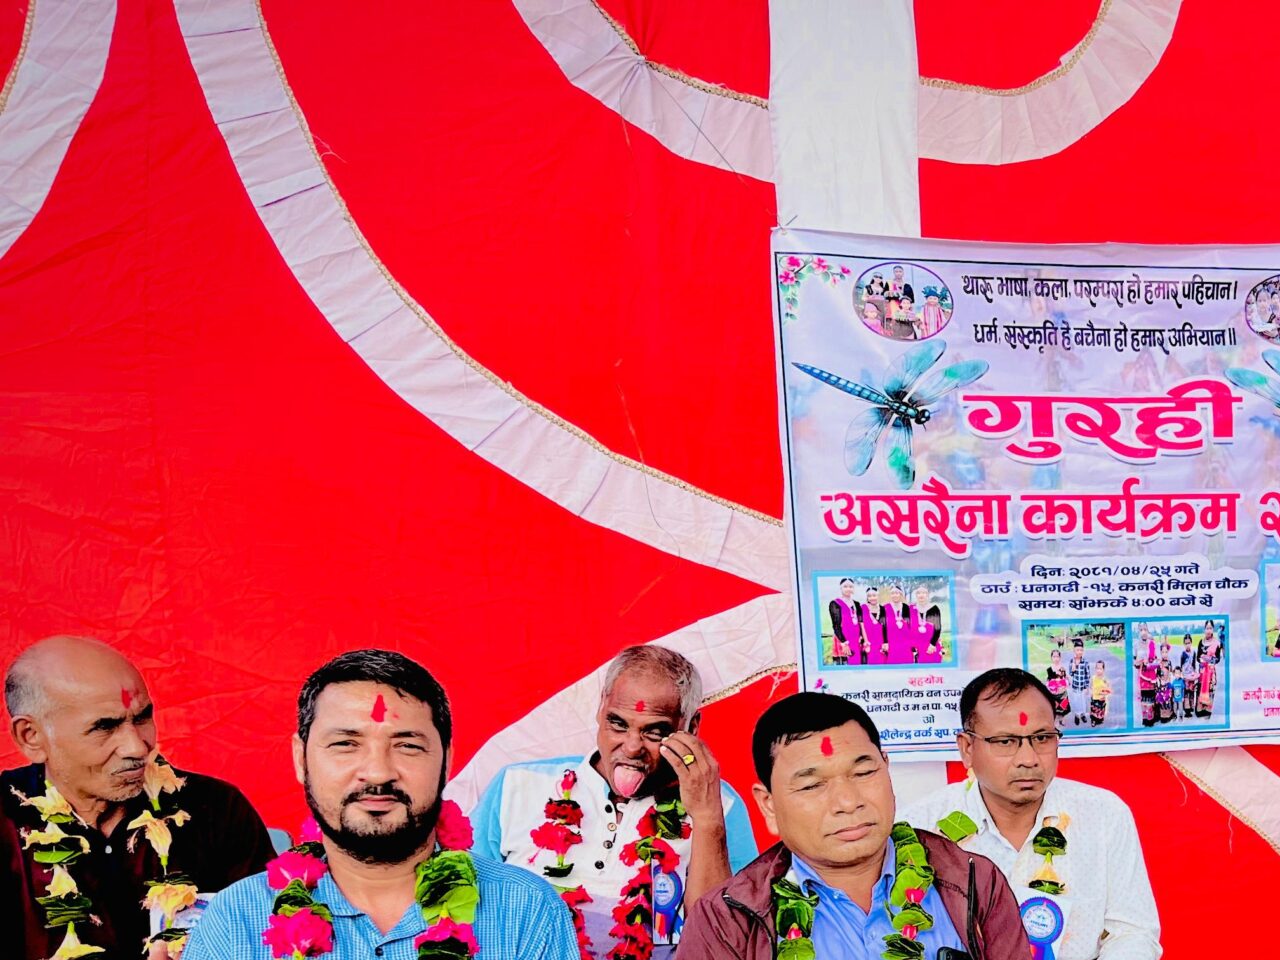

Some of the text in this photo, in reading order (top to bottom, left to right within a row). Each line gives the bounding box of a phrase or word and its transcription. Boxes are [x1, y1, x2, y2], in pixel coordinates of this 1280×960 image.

[962, 275, 993, 303] थारू
[1074, 279, 1124, 307] परम्परा
[1127, 273, 1141, 304] हो
[1144, 280, 1182, 309] हमार
[1003, 320, 1058, 353] संस्कृति
[1073, 320, 1111, 347] बचैना
[1114, 321, 1127, 352] हो
[1130, 328, 1169, 355] हमार
[963, 380, 1243, 460] गुरही
[821, 476, 1011, 555] असरैना
[1021, 478, 1240, 540] कार्यक्रम
[1117, 578, 1164, 595] कनरी
[1167, 578, 1212, 591] मिलन
[1215, 577, 1250, 590] चौक
[1174, 562, 1200, 575] गते
[1169, 594, 1196, 607] बजे
[1199, 593, 1214, 608] से
